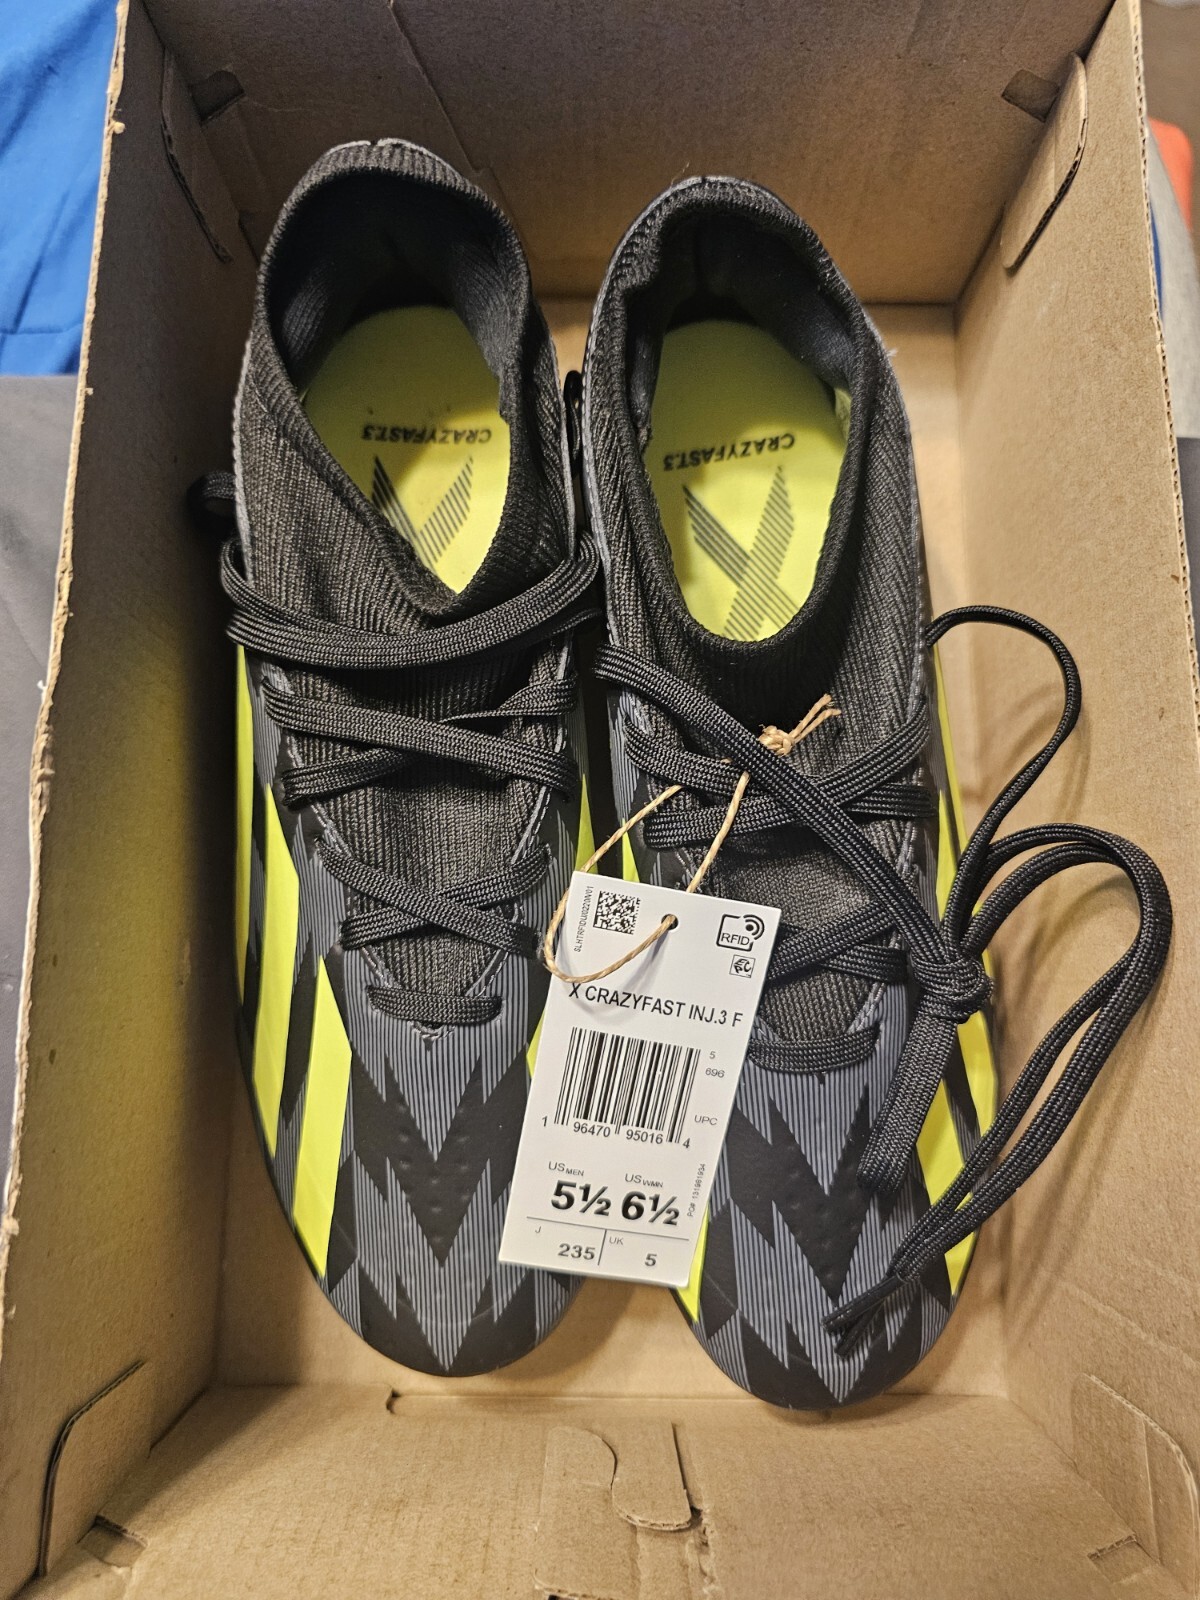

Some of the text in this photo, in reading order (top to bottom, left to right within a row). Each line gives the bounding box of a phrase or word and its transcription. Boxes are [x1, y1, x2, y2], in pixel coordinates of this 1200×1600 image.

[720, 932, 750, 946] RFID
[568, 983, 743, 1027] X CRAZYFAST INJ.3 F
[709, 1051, 716, 1060] 5
[705, 1067, 725, 1078] 696
[694, 1114, 718, 1126] UPC
[542, 1116, 691, 1149] 1 96470 95016 4
[535, 1226, 541, 1234] J
[609, 1236, 624, 1245] UK
[558, 1243, 595, 1260] 235
[644, 1253, 657, 1267] 5
